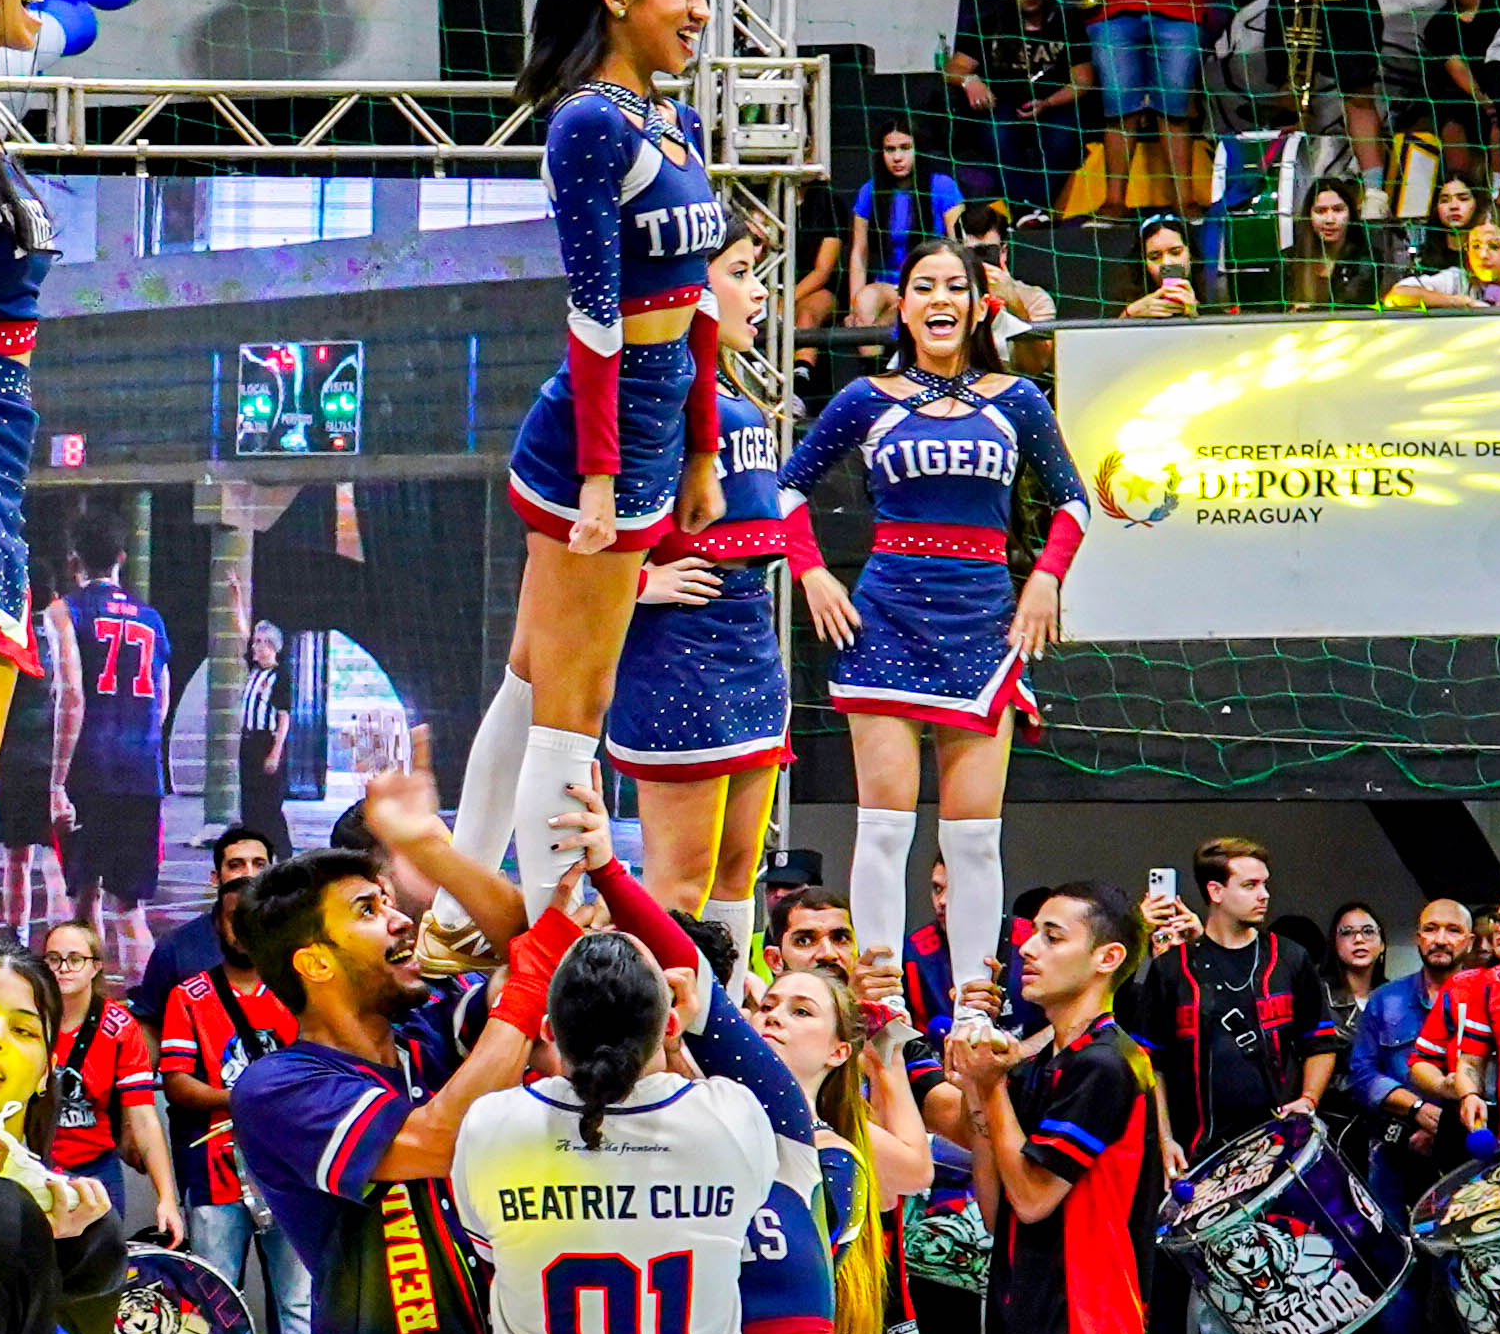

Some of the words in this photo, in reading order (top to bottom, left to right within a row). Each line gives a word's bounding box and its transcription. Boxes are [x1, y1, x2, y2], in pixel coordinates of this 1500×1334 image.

[873, 438, 1018, 486] TIGERS
[1197, 439, 1337, 460] SECRETARÍA
[1345, 441, 1468, 459] NACIONAL
[1200, 467, 1417, 500] DEPORTES
[1197, 507, 1323, 525] PARAGUAY
[93, 617, 155, 697] 77
[498, 1184, 638, 1223] BEATRIZ
[648, 1184, 736, 1220] CLUG
